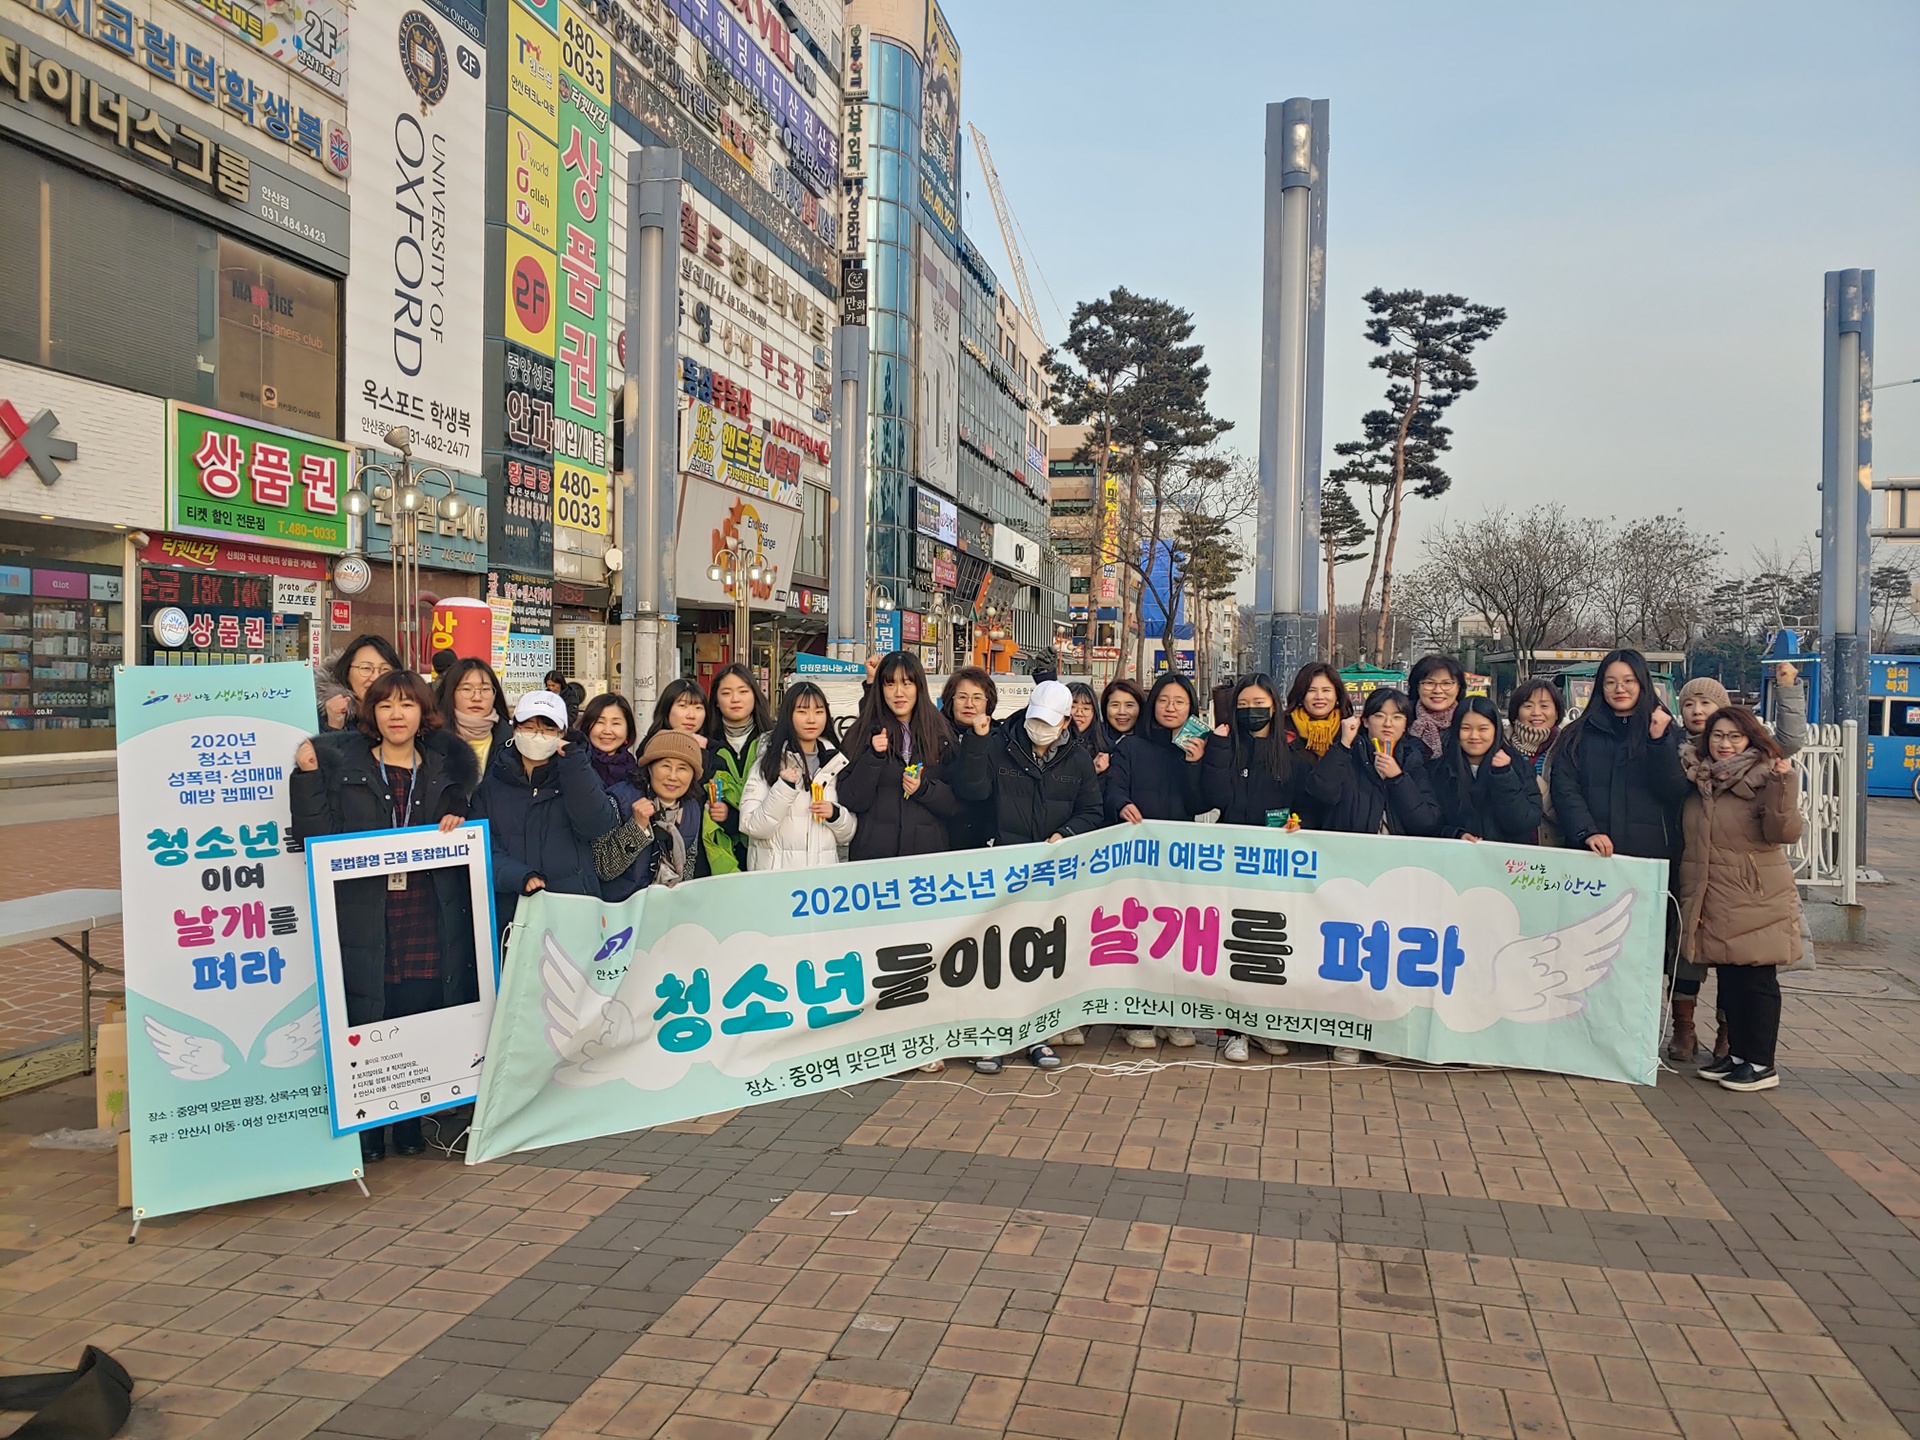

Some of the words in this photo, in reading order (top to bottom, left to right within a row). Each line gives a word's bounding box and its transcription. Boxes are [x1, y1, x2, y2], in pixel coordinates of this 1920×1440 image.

[304, 10, 338, 58] 2F
[450, 8, 480, 39] OXFORD
[562, 16, 603, 59] 480-
[31, 0, 323, 158] 시코런던학생복
[461, 51, 477, 74] 2F
[562, 40, 605, 95] 0033
[847, 104, 863, 170] 산부인과
[529, 157, 549, 177] world
[260, 185, 290, 211] 안산점
[529, 186, 550, 208] olleh
[260, 205, 326, 244] 031.484.3423
[430, 133, 446, 298] UNIVERSITY
[393, 112, 426, 377] OXFORD
[681, 201, 725, 267] 월드
[560, 124, 602, 417] 상품권
[232, 278, 294, 318] MASSTIGE
[516, 269, 546, 315] 2F
[845, 295, 867, 311] 만화
[252, 313, 300, 342] Designers
[302, 331, 323, 349] club
[429, 302, 445, 344] OF
[845, 312, 867, 327] 카페
[507, 352, 554, 393] 중앙성모
[760, 342, 806, 400] 무도장
[362, 378, 425, 421] 옥스포드
[429, 400, 471, 437] 학생복
[506, 390, 554, 454] 안과
[697, 403, 717, 425] 031-
[409, 428, 470, 459] 31-482-2477
[554, 416, 605, 467] 매입/매출
[694, 422, 715, 442] 401-
[721, 421, 763, 474] 핸드폰
[772, 417, 820, 456] LOTTERIA
[692, 438, 714, 464] 7958
[191, 430, 338, 516] 상품권
[508, 460, 551, 494] 황금당
[559, 469, 599, 500] 480-
[186, 505, 207, 522] 티켓
[211, 509, 233, 526] 할인
[235, 513, 266, 531] 전문점
[558, 496, 600, 529] 0033
[747, 515, 769, 534] Endless
[277, 520, 337, 541] T.480-0033
[757, 532, 777, 552] Change
[161, 537, 219, 566] 티켓나라
[226, 550, 247, 562] 신뢰와
[191, 573, 223, 604] 18K
[278, 583, 300, 592] proto
[278, 594, 317, 607] 스포츠토토
[189, 613, 265, 649] 상품권
[843, 664, 859, 673] 사업
[1886, 666, 1909, 679] 열쇠
[261, 687, 292, 700] 안산
[1344, 681, 1377, 692] 名品
[190, 731, 257, 749] 2020년
[197, 750, 252, 768] 청소년
[167, 766, 284, 788] 성폭력·성매매
[179, 790, 216, 805] 예방
[220, 785, 275, 803] 캠페인
[383, 850, 409, 866] 근절
[411, 843, 471, 863] 동참합니다
[201, 862, 265, 893] 이여
[791, 878, 901, 918] 2020년
[909, 868, 997, 907] 청소년
[1004, 838, 1160, 894] 성폭력·성매매
[1168, 841, 1226, 873] 예방
[1233, 846, 1318, 880] 캠페인
[1563, 878, 1607, 897] 안산
[173, 900, 299, 948] 날개를
[192, 946, 287, 991] 펴라
[652, 912, 1068, 1054] 청소년들이여
[1089, 896, 1294, 987] 날개를
[1317, 920, 1467, 996] 펴라
[1081, 997, 1109, 1015] 주관
[1124, 995, 1175, 1018] 안산시
[1181, 1000, 1259, 1029] 아동·여성
[1264, 1013, 1375, 1042] 안전지역연대
[744, 1077, 778, 1098] 장소
[789, 1056, 841, 1088] 중앙역
[845, 1044, 898, 1075] 맞은편
[901, 1032, 940, 1060] 광장,
[945, 1025, 1014, 1049] 상록수역
[1018, 1022, 1031, 1042] 앞
[1034, 1008, 1062, 1033] 광장
[148, 1110, 168, 1123] 장소
[176, 1102, 208, 1119] 중앙역
[210, 1097, 242, 1113] 맞은편
[269, 1086, 310, 1103] 상록수역
[310, 1084, 322, 1097] 앞
[148, 1132, 169, 1144] 주관
[177, 1123, 212, 1140] 안산시
[213, 1116, 264, 1134] 아동·여성
[265, 1105, 329, 1125] 안전지역연대
